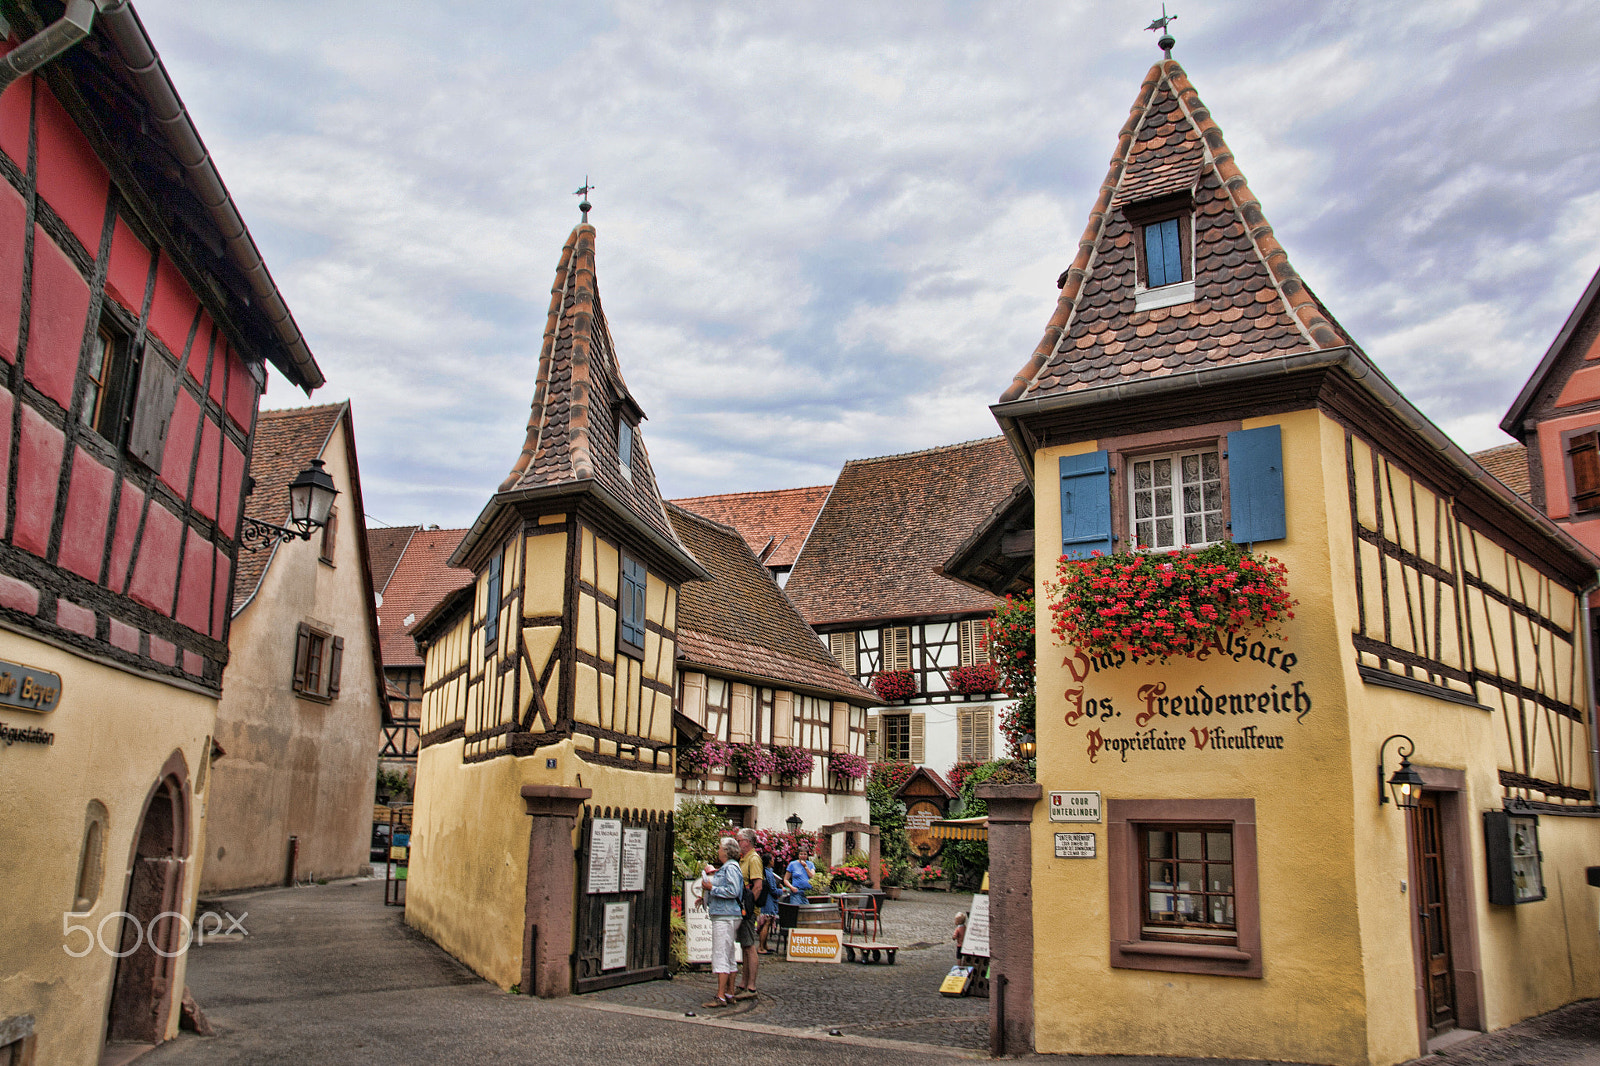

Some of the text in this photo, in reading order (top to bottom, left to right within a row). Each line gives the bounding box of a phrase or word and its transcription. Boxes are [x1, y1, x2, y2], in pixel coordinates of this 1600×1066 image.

[21, 675, 59, 708] Beyer
[1135, 680, 1312, 727] Freudenreich
[1086, 725, 1285, 764] Propriétaire Viticulteur
[1070, 797, 1089, 805] COUR
[1051, 808, 1098, 817] UNTERLINDEN
[791, 935, 819, 945] VENTE &
[791, 943, 837, 955] DÉGUSTATION
